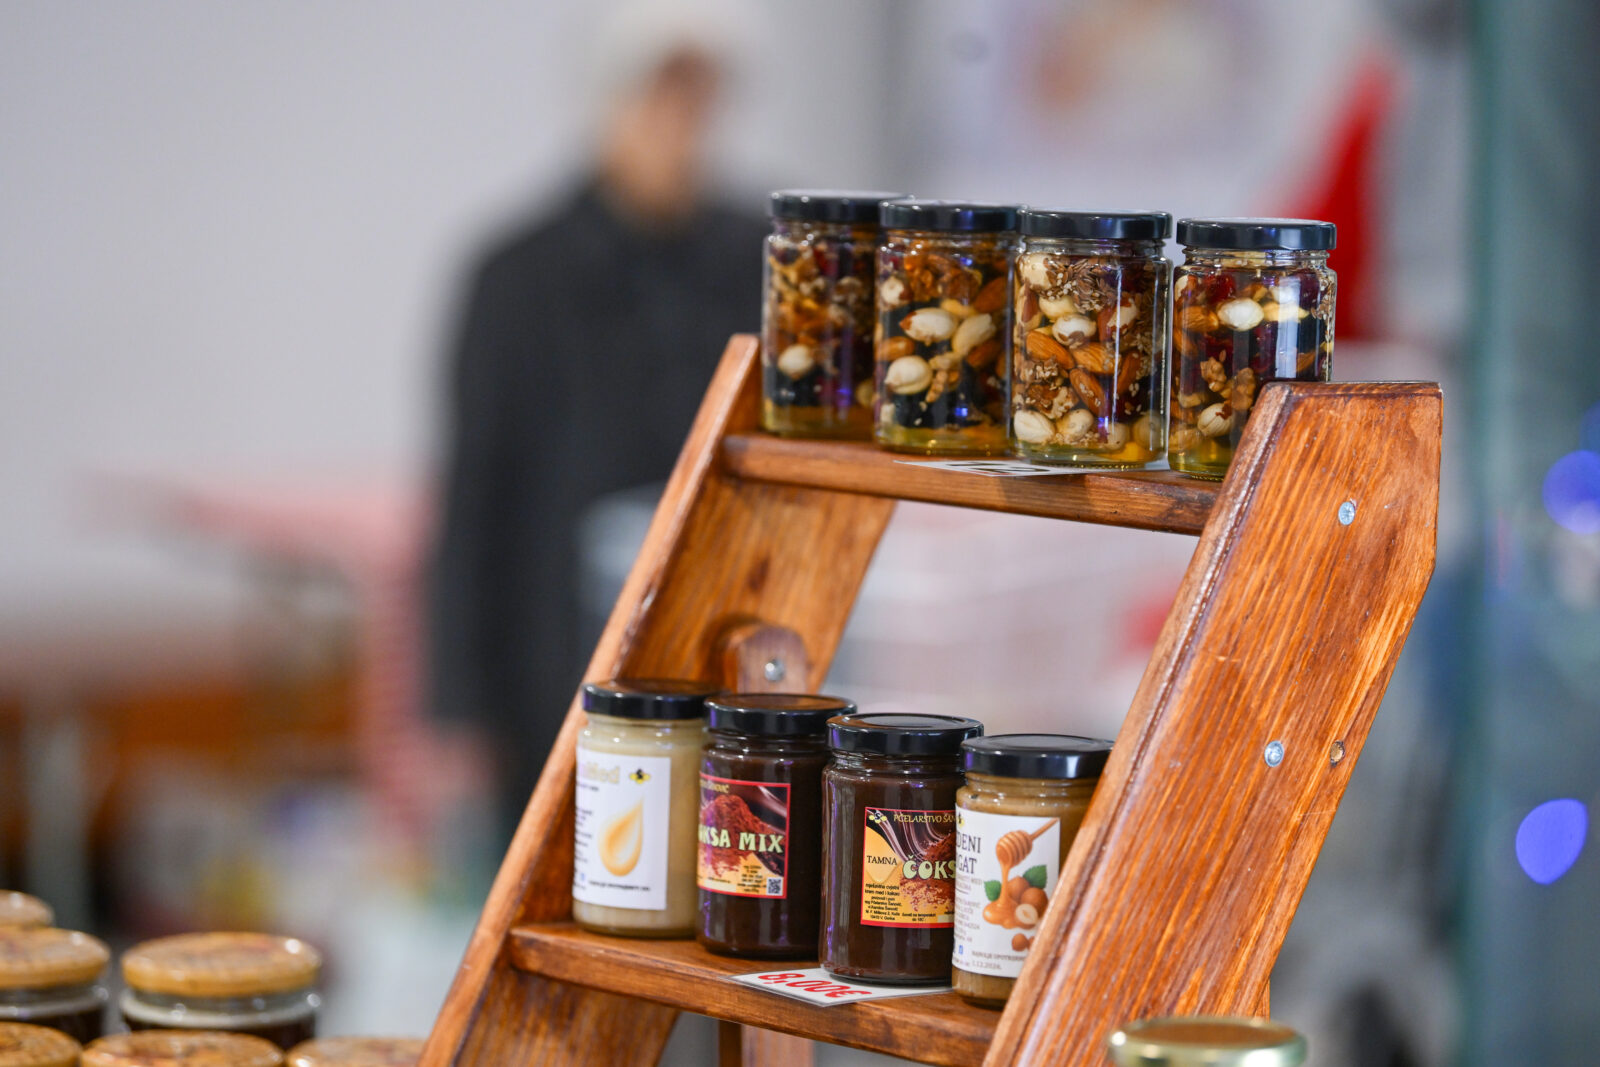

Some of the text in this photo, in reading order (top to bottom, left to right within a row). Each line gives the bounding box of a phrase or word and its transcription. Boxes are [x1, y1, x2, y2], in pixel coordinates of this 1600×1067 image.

[893, 813, 942, 823] PČELARSTVO
[739, 832, 783, 853] MIX
[867, 855, 898, 865] TAMNA
[758, 973, 872, 998] 8,00€
